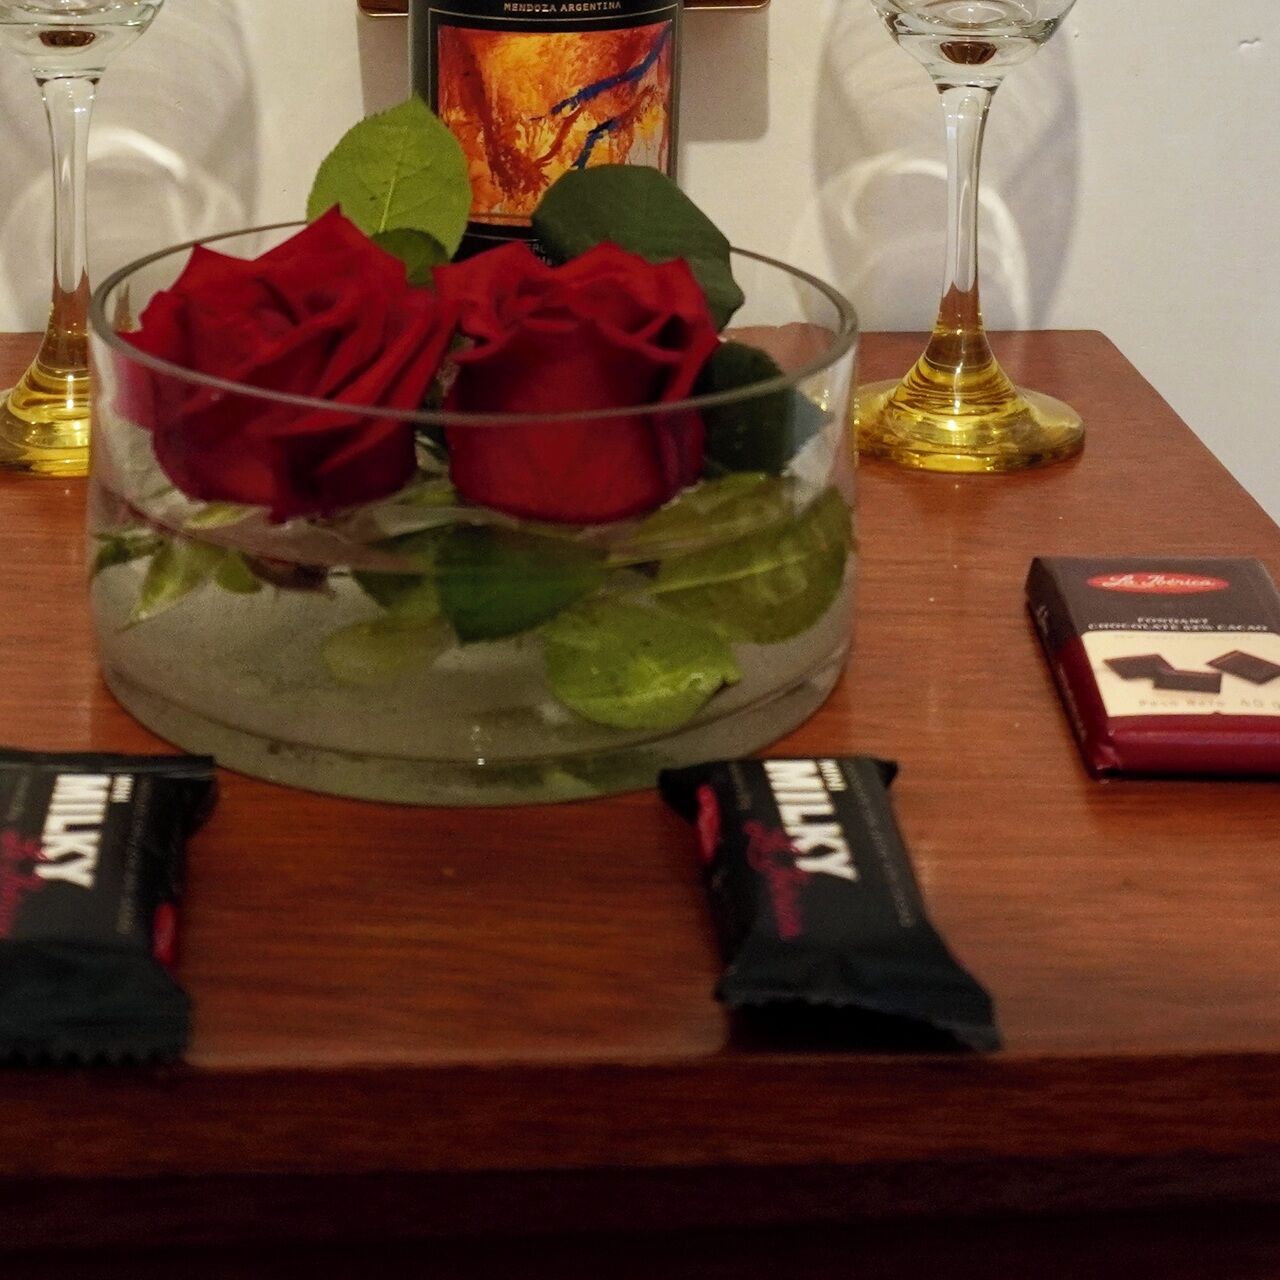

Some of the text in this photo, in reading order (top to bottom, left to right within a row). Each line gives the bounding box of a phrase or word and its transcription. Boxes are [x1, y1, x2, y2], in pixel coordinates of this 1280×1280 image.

[503, 0, 622, 13] MENDOZA ARGENTINA
[32, 773, 112, 889] MILKY
[762, 758, 861, 883] MILKY
